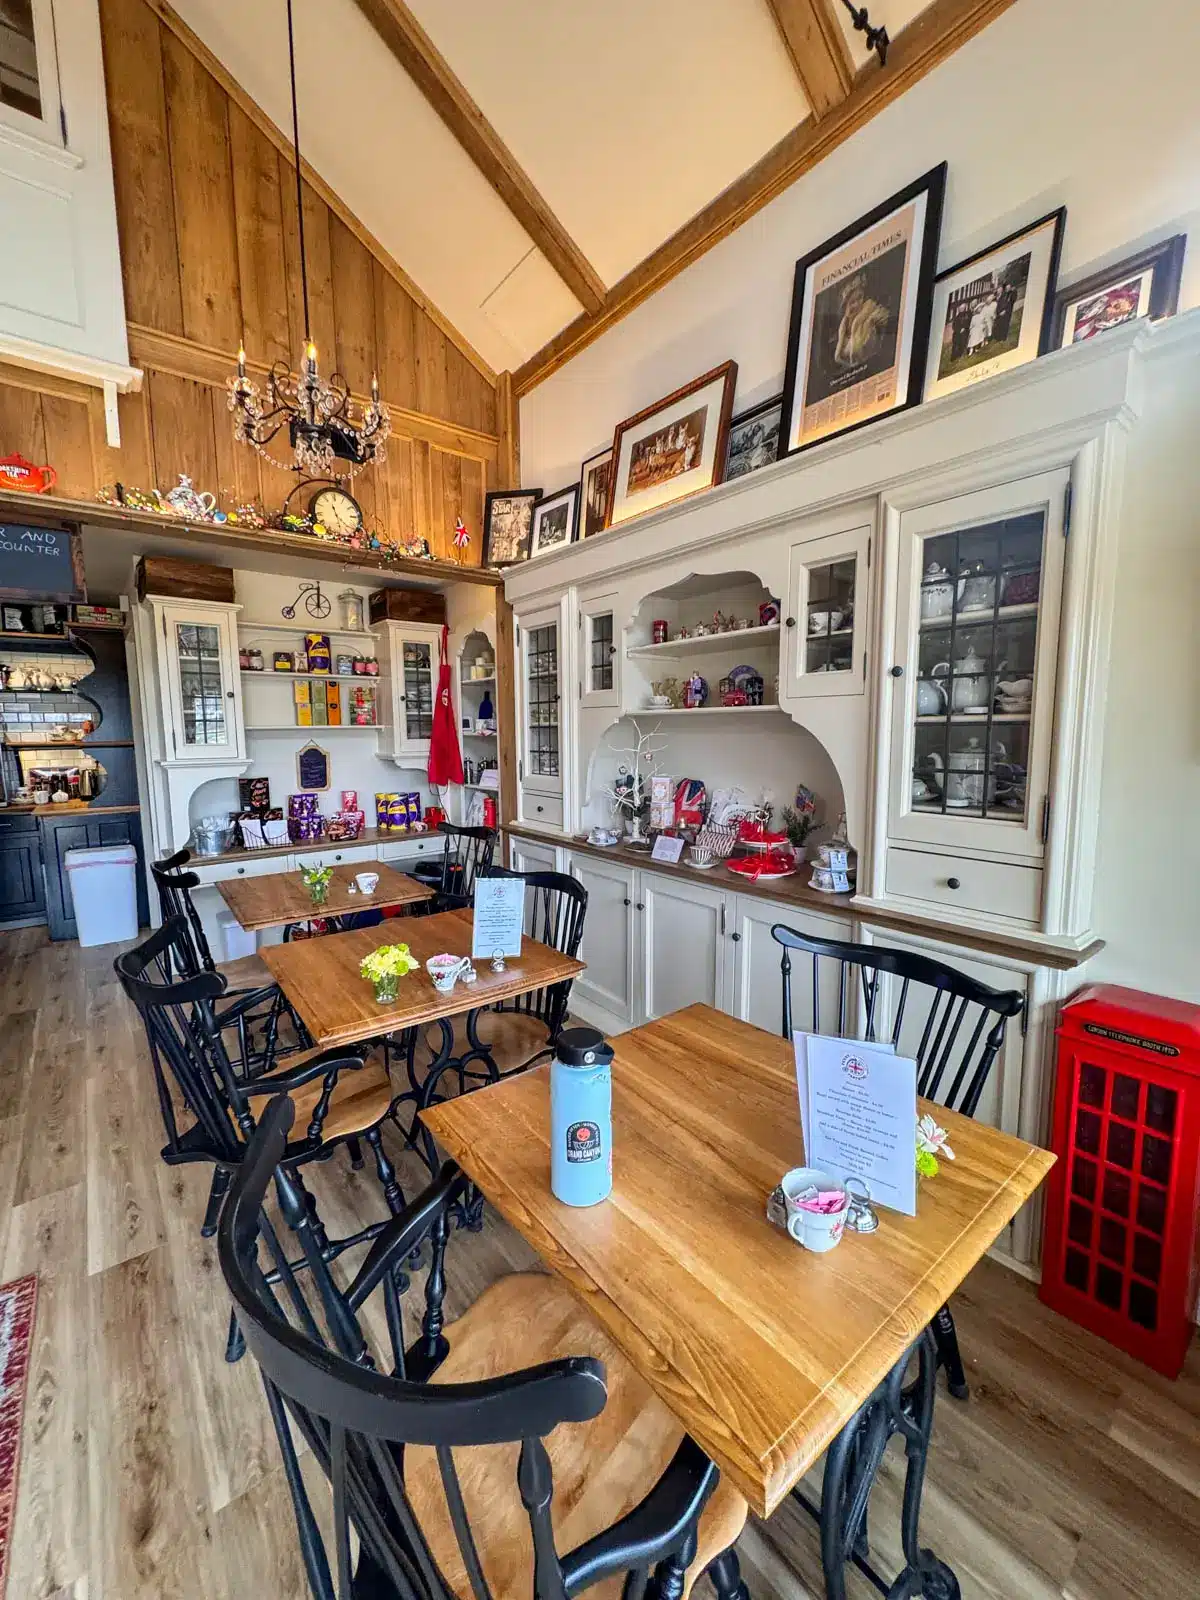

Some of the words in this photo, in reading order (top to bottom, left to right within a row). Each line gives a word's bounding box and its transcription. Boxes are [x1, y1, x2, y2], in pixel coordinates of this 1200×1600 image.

[822, 252, 869, 285] FINANCIAL
[872, 229, 902, 254] TIMES
[21, 531, 56, 544] AND
[1108, 1032, 1140, 1045] TELEPHONE
